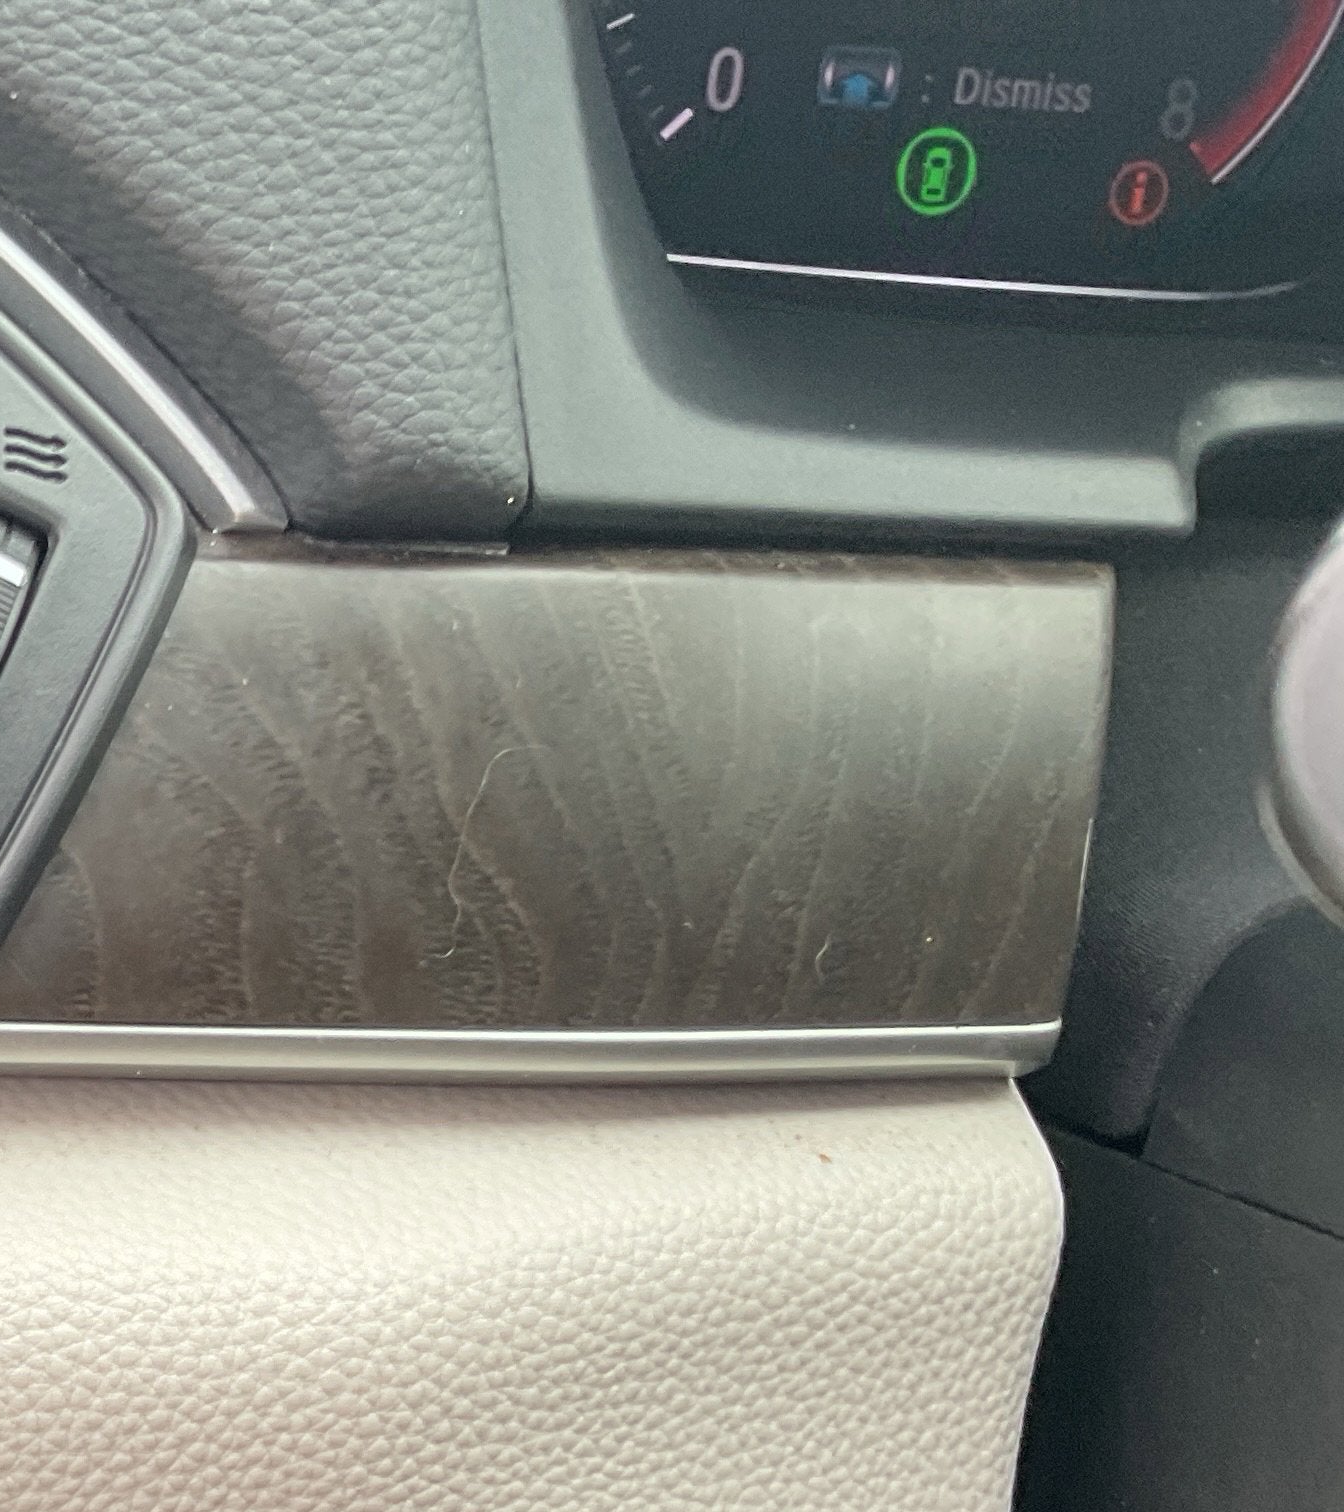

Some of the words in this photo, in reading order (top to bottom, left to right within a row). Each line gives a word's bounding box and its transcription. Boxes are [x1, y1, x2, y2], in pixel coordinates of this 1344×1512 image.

[706, 47, 744, 111] 0
[954, 66, 1093, 113] Dismiss
[1160, 78, 1197, 140] 8
